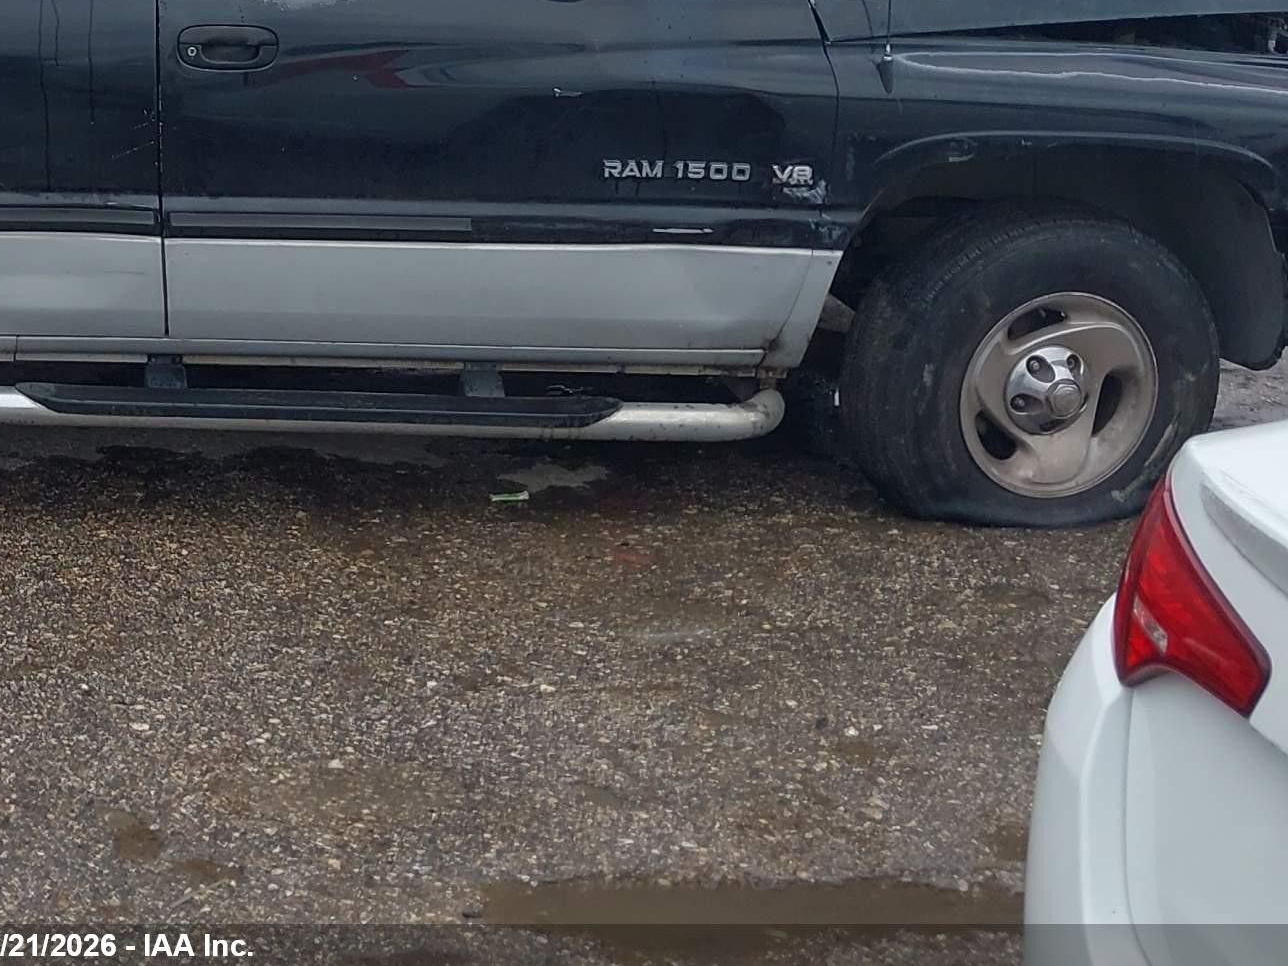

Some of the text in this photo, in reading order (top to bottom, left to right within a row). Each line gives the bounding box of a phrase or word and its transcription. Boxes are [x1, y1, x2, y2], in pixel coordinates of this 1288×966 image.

[602, 159, 664, 179] RAM
[673, 160, 752, 182] 1500
[772, 164, 813, 182] V8
